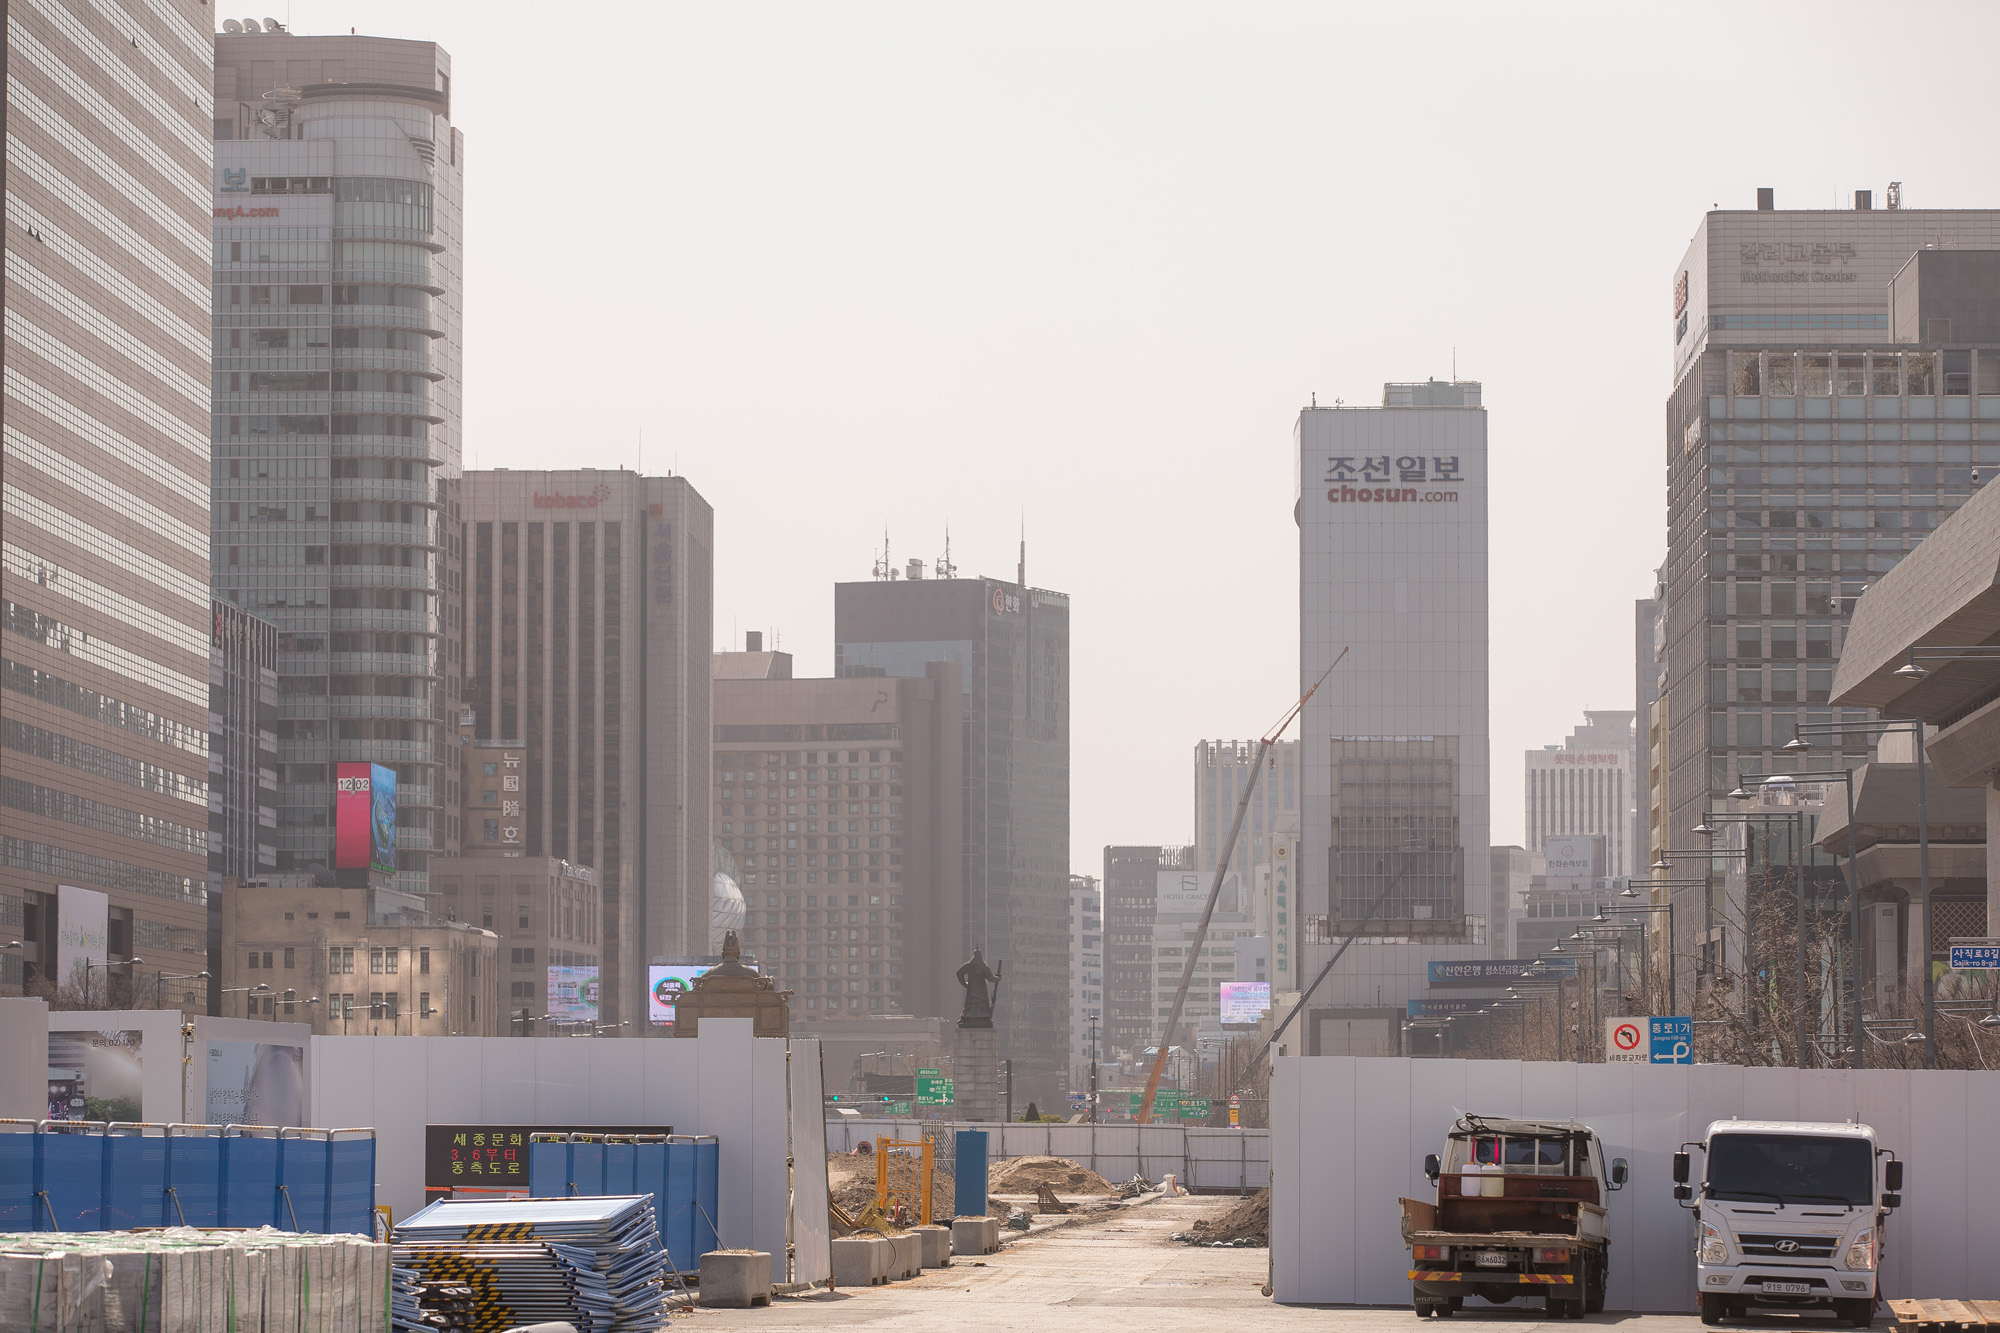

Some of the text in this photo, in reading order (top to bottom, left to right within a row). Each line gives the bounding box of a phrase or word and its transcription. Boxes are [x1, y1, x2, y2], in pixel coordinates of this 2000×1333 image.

[1740, 241, 1857, 265] 감리교본부
[1741, 271, 1857, 283] Methodist Center
[1324, 456, 1464, 482] 조선일보
[1327, 484, 1458, 502] chosun.com
[533, 491, 598, 508] kobaco
[1554, 754, 1618, 765] 롯데손해보험
[1548, 860, 1589, 868] 한화손해보험
[1278, 865, 1287, 972] 서울특별시의회
[1953, 949, 1999, 959] 사직로8길
[1953, 959, 1998, 967] Sajik-ro 8-gil
[1445, 965, 1481, 977] 신한은행
[1608, 1053, 1648, 1062] 세종로교차로
[1785, 1284, 1806, 1293] 0796
